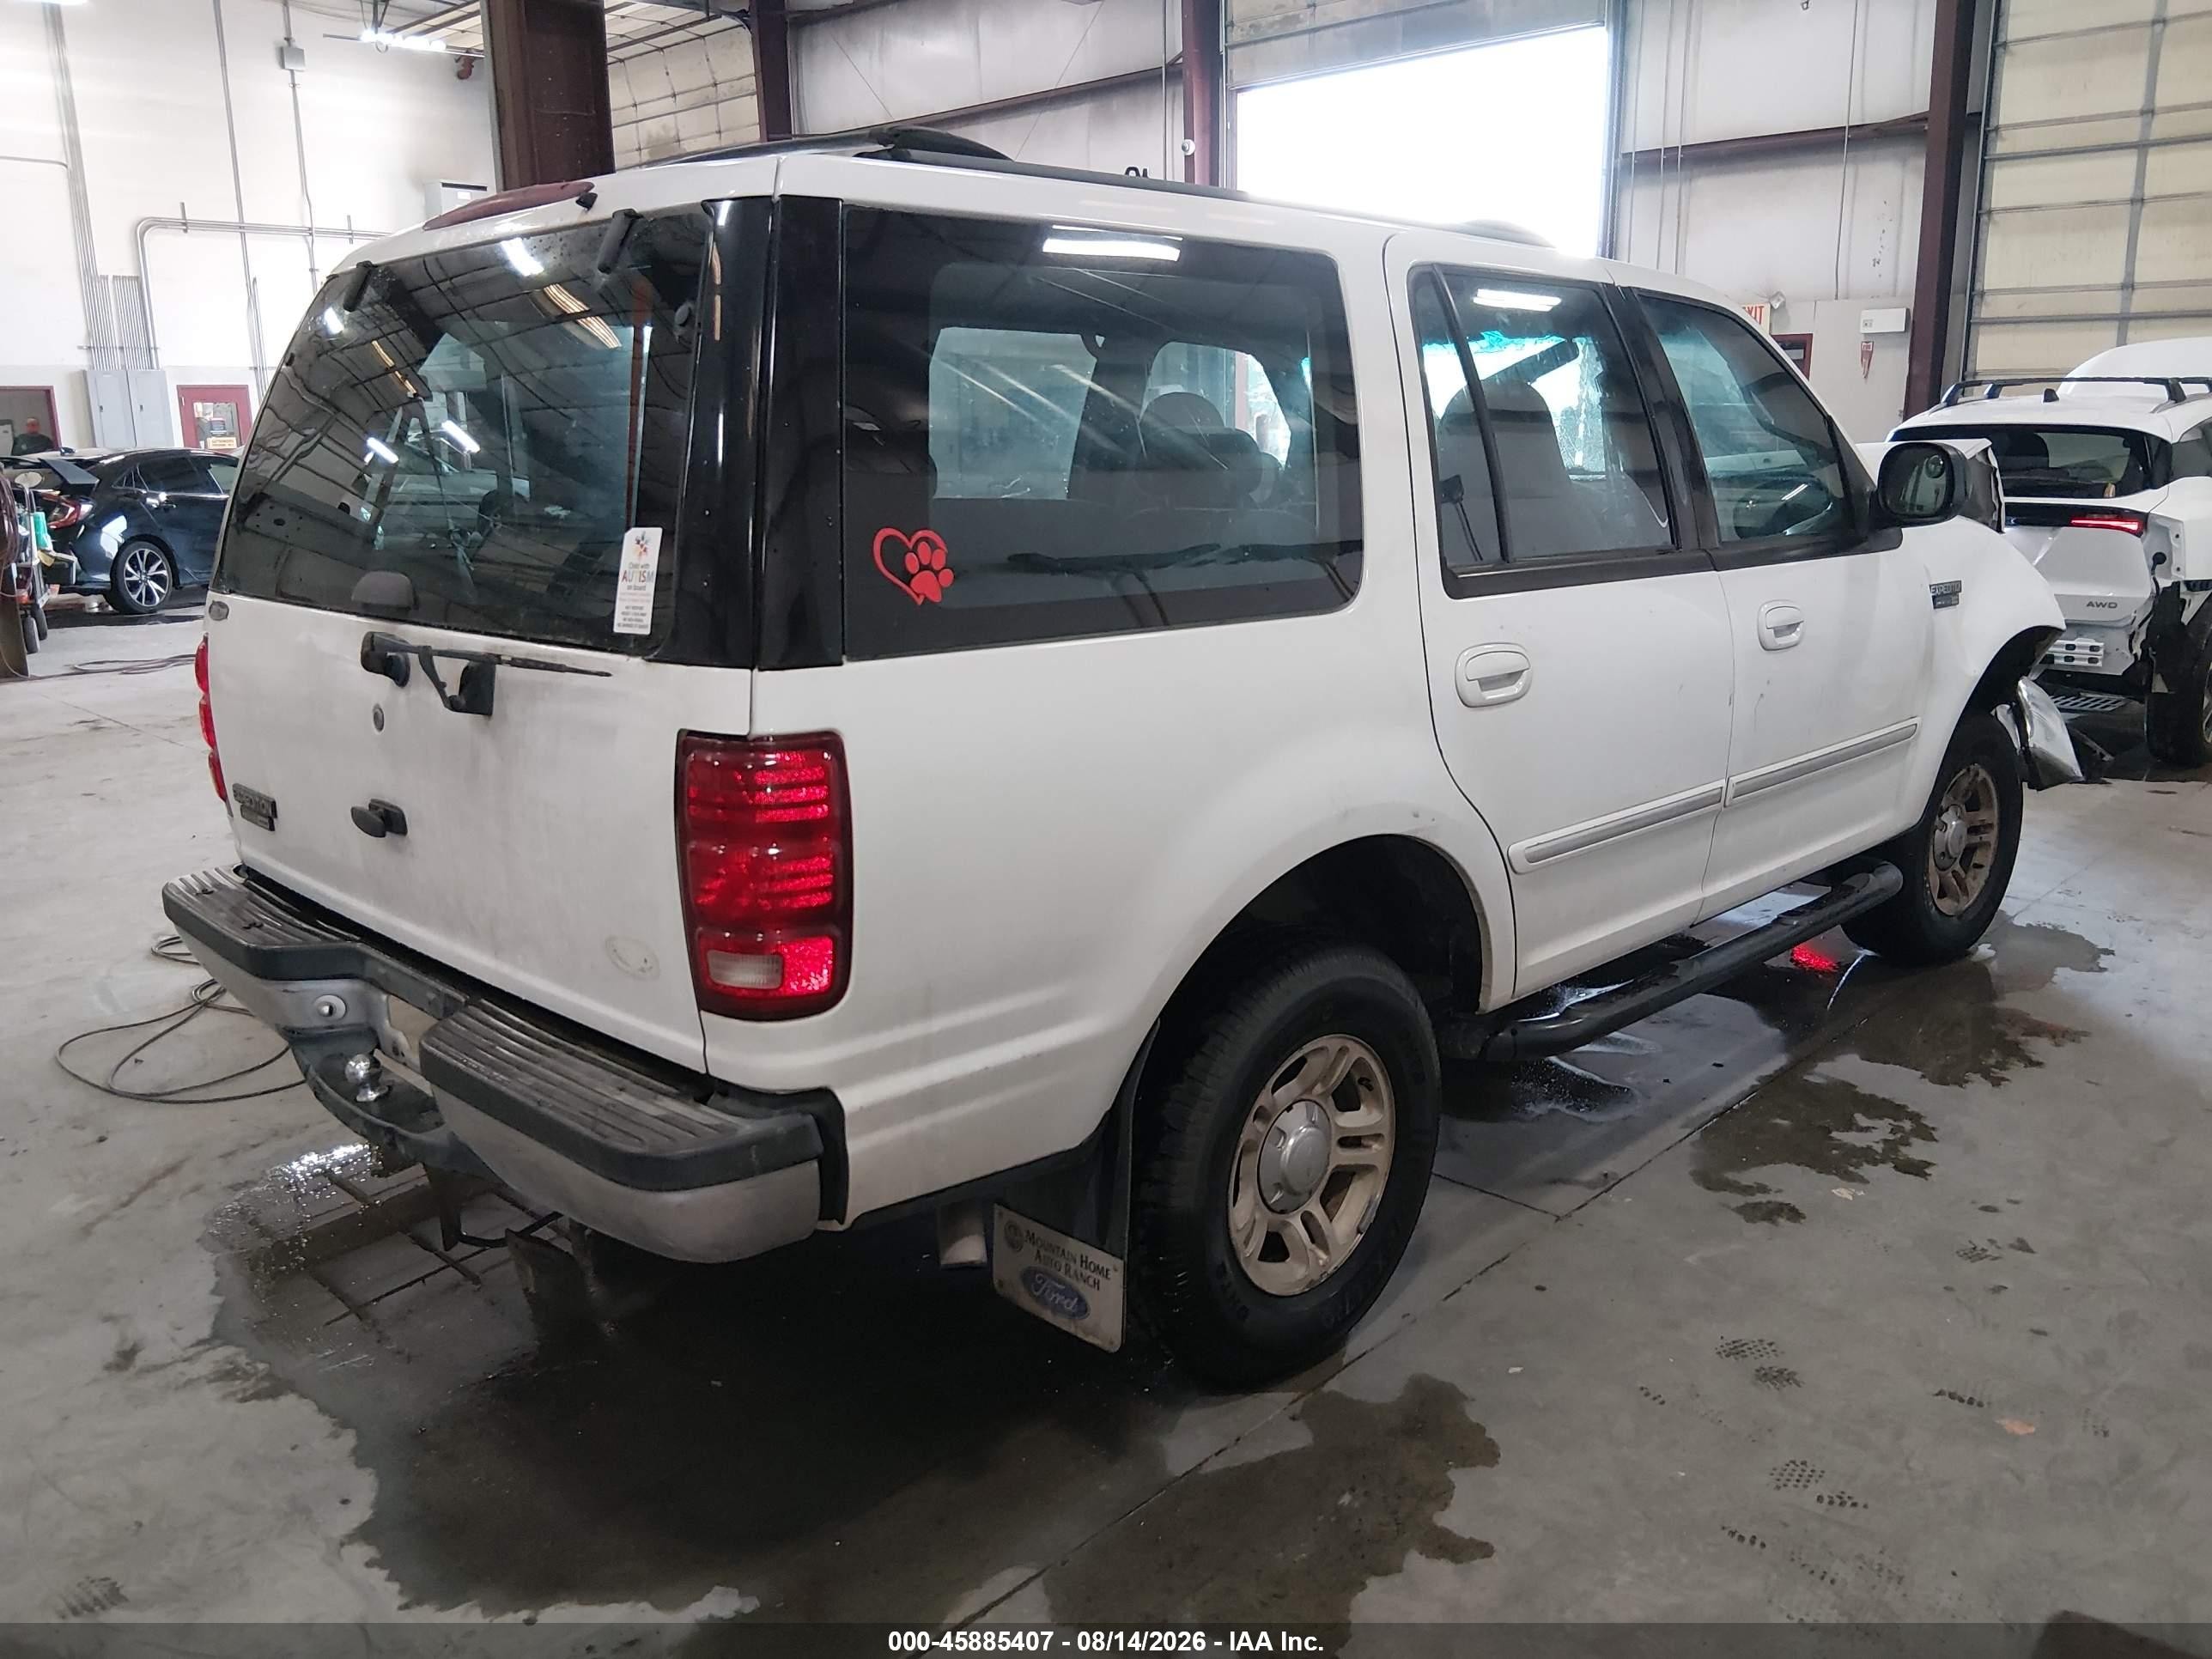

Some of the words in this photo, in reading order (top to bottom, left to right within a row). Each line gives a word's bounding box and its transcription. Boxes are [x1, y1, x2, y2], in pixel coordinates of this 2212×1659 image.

[1742, 305, 1765, 325] XIT
[622, 570, 654, 583] AUTISM
[1064, 1263, 1101, 1291] RANCH
[1080, 1254, 1111, 1280] HOME
[1031, 1273, 1079, 1313] Ford
